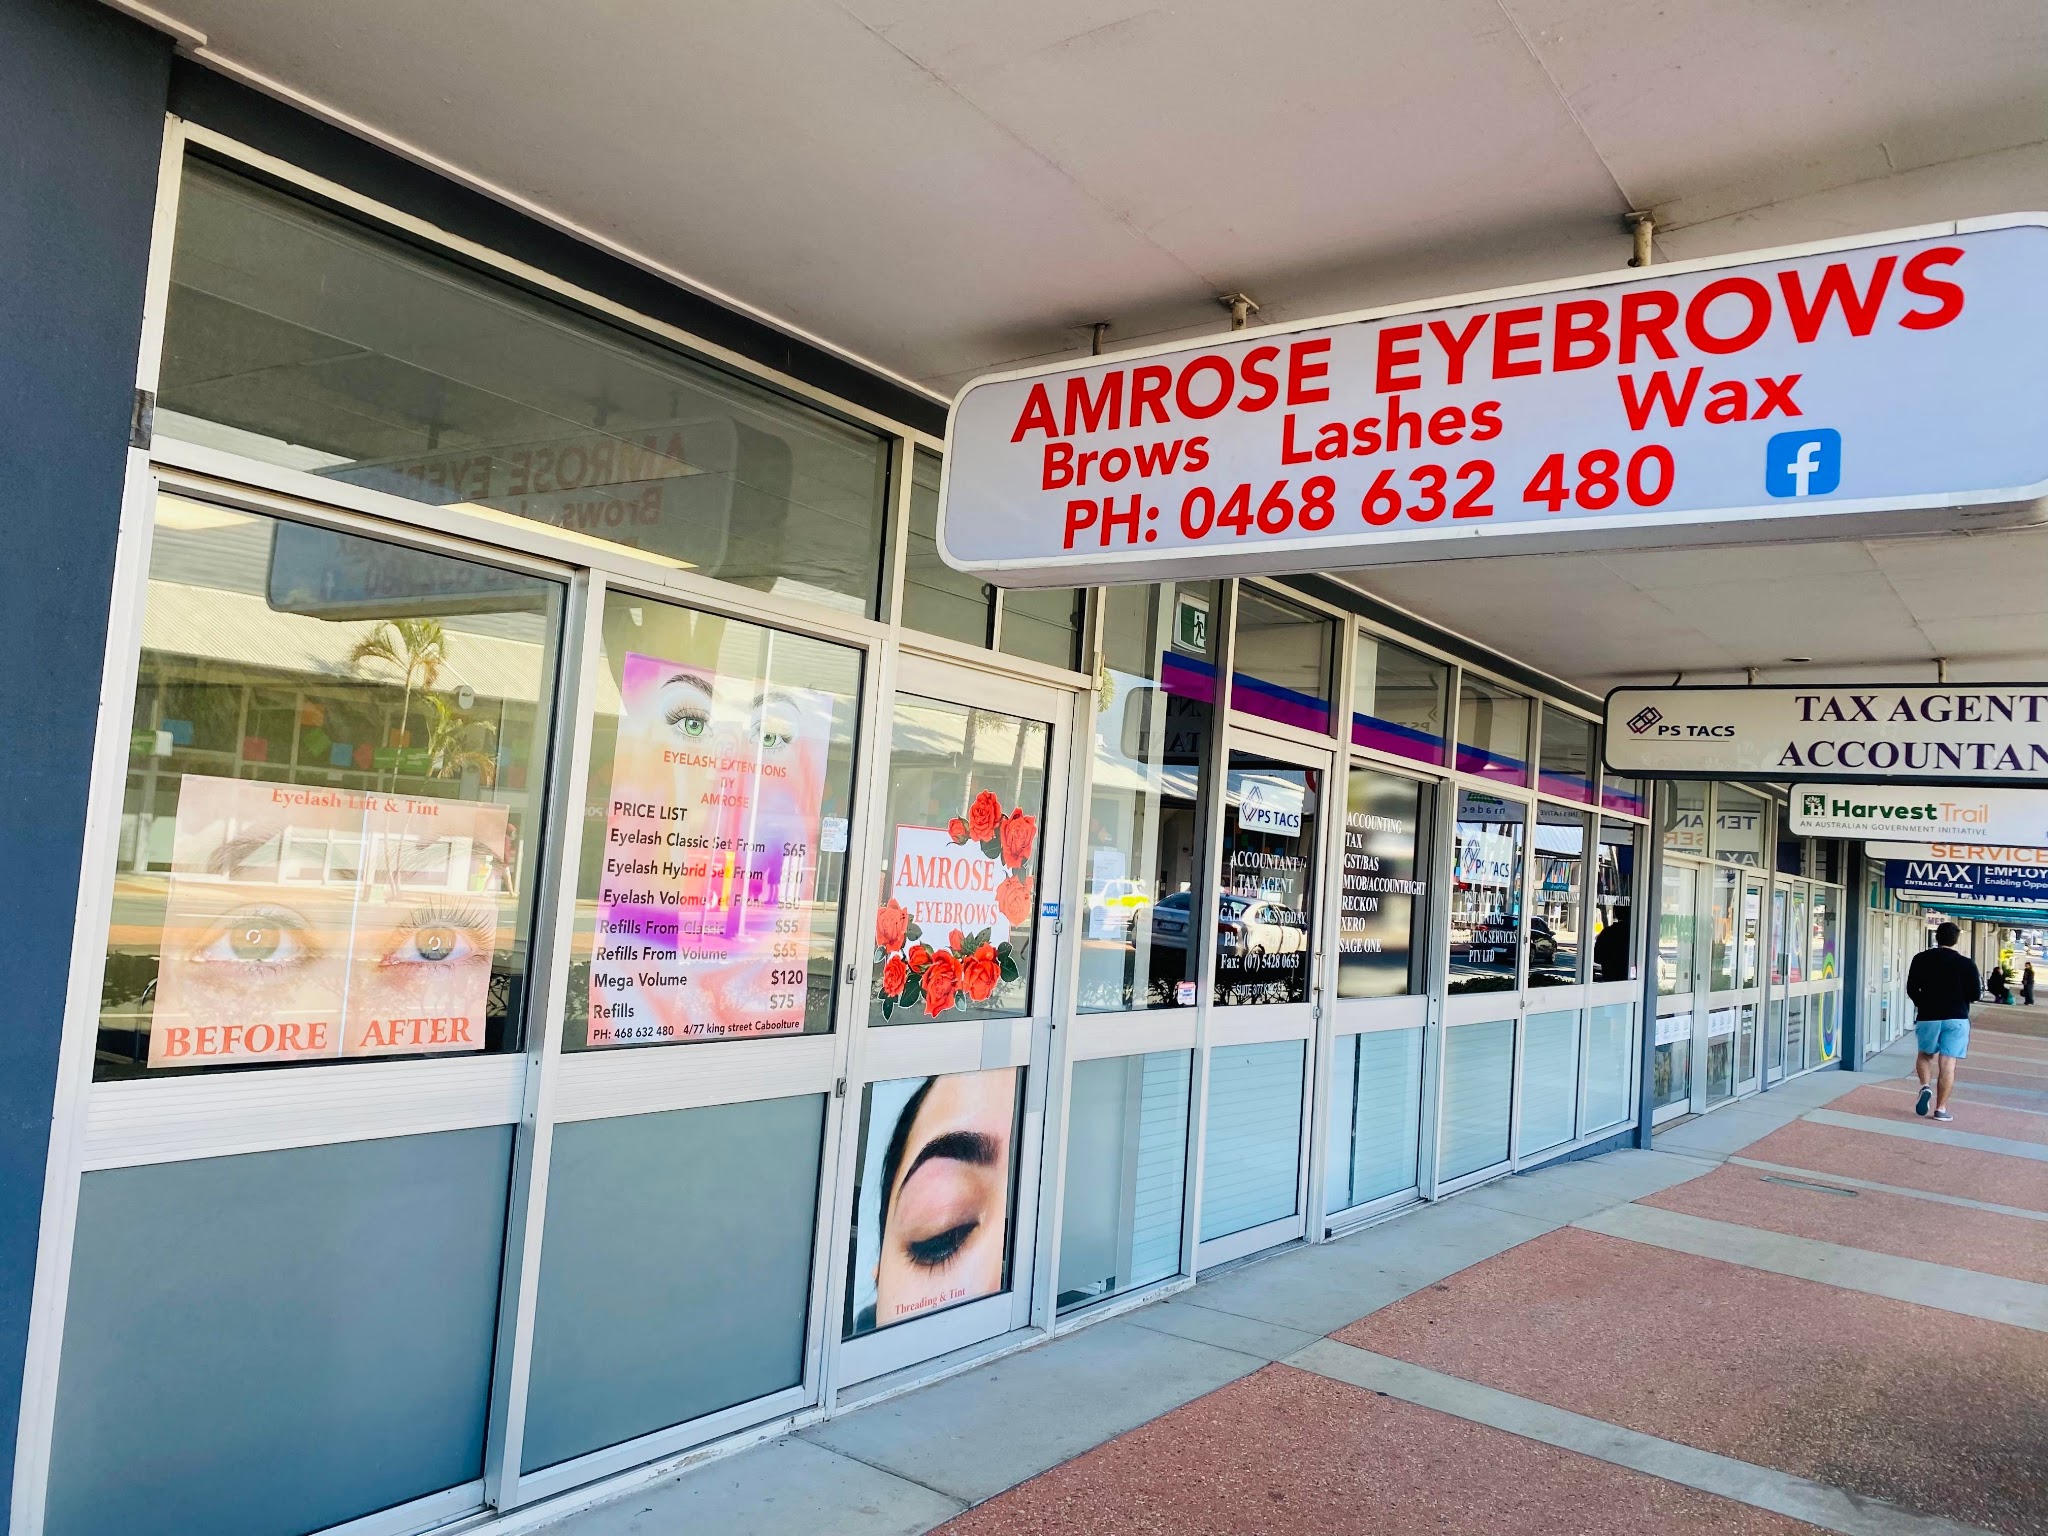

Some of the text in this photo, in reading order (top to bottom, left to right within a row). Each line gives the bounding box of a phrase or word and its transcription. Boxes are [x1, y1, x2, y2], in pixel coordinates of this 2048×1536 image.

[1010, 247, 1965, 443] AMROSE EYEBROWS
[1042, 366, 1804, 491] Brows Lashes Wax
[1063, 444, 1675, 549] PH: 0468 632 480
[1795, 695, 2048, 723] TAX AGENT
[1658, 725, 1735, 737] PS TACS
[664, 751, 787, 778] EYELASH EXTENIONS
[271, 788, 439, 816] Eyelash Lift & Tint
[701, 793, 750, 809] AMROSE
[613, 802, 656, 818] PRICE
[660, 806, 687, 821] LIST
[1257, 809, 1299, 828] PS TACS
[1832, 799, 1989, 823] Harvest Trail
[1346, 812, 1402, 834] ACCOUNTING
[1815, 821, 1868, 831] AUSTRALIAN
[1871, 824, 1935, 833] GOVERNMENT
[1938, 826, 1988, 836] INITIATIVE
[610, 828, 662, 846] Eyelash
[667, 832, 709, 849] Classic
[712, 836, 732, 850] Set
[783, 841, 806, 858] $65
[1345, 832, 1362, 848] TAX
[607, 859, 658, 876] Eyelash
[662, 861, 706, 879] Hybrid
[1344, 853, 1379, 872] GST/BAS
[1905, 862, 1972, 882] MAX
[896, 853, 998, 925] AMROSE EYEBROWS
[1238, 873, 1294, 893] TAX AGENT
[1342, 874, 1426, 896] MYOB/ACCOUNTRIGHT
[1905, 879, 1942, 888] ENTRANCE
[1984, 878, 2021, 888] Enabling
[603, 889, 657, 908] Eyelash
[734, 894, 763, 908] Fom
[1341, 895, 1379, 912] RECKON
[1536, 891, 1554, 902] SALL
[1042, 905, 1058, 915] PUSH
[1220, 908, 1243, 922] CAL
[600, 919, 799, 936] Refills From Classic $55
[1340, 916, 1366, 932] XERO
[1339, 938, 1382, 953] SAGE ONE
[1488, 930, 1517, 944] SERVICES
[596, 943, 797, 961] Refills From Volume $65
[1468, 949, 1495, 963] PTY LTD
[1221, 953, 1299, 972] Fax: (07) 5428 0653
[594, 969, 804, 991] Mega Volume $120
[593, 993, 794, 1019] Refills $75
[162, 1017, 472, 1058] BEFORE AFTER
[593, 1019, 800, 1040] PH: 468 632 480 4/77 king street Caboolture
[895, 1288, 966, 1315] Threading & Tint
